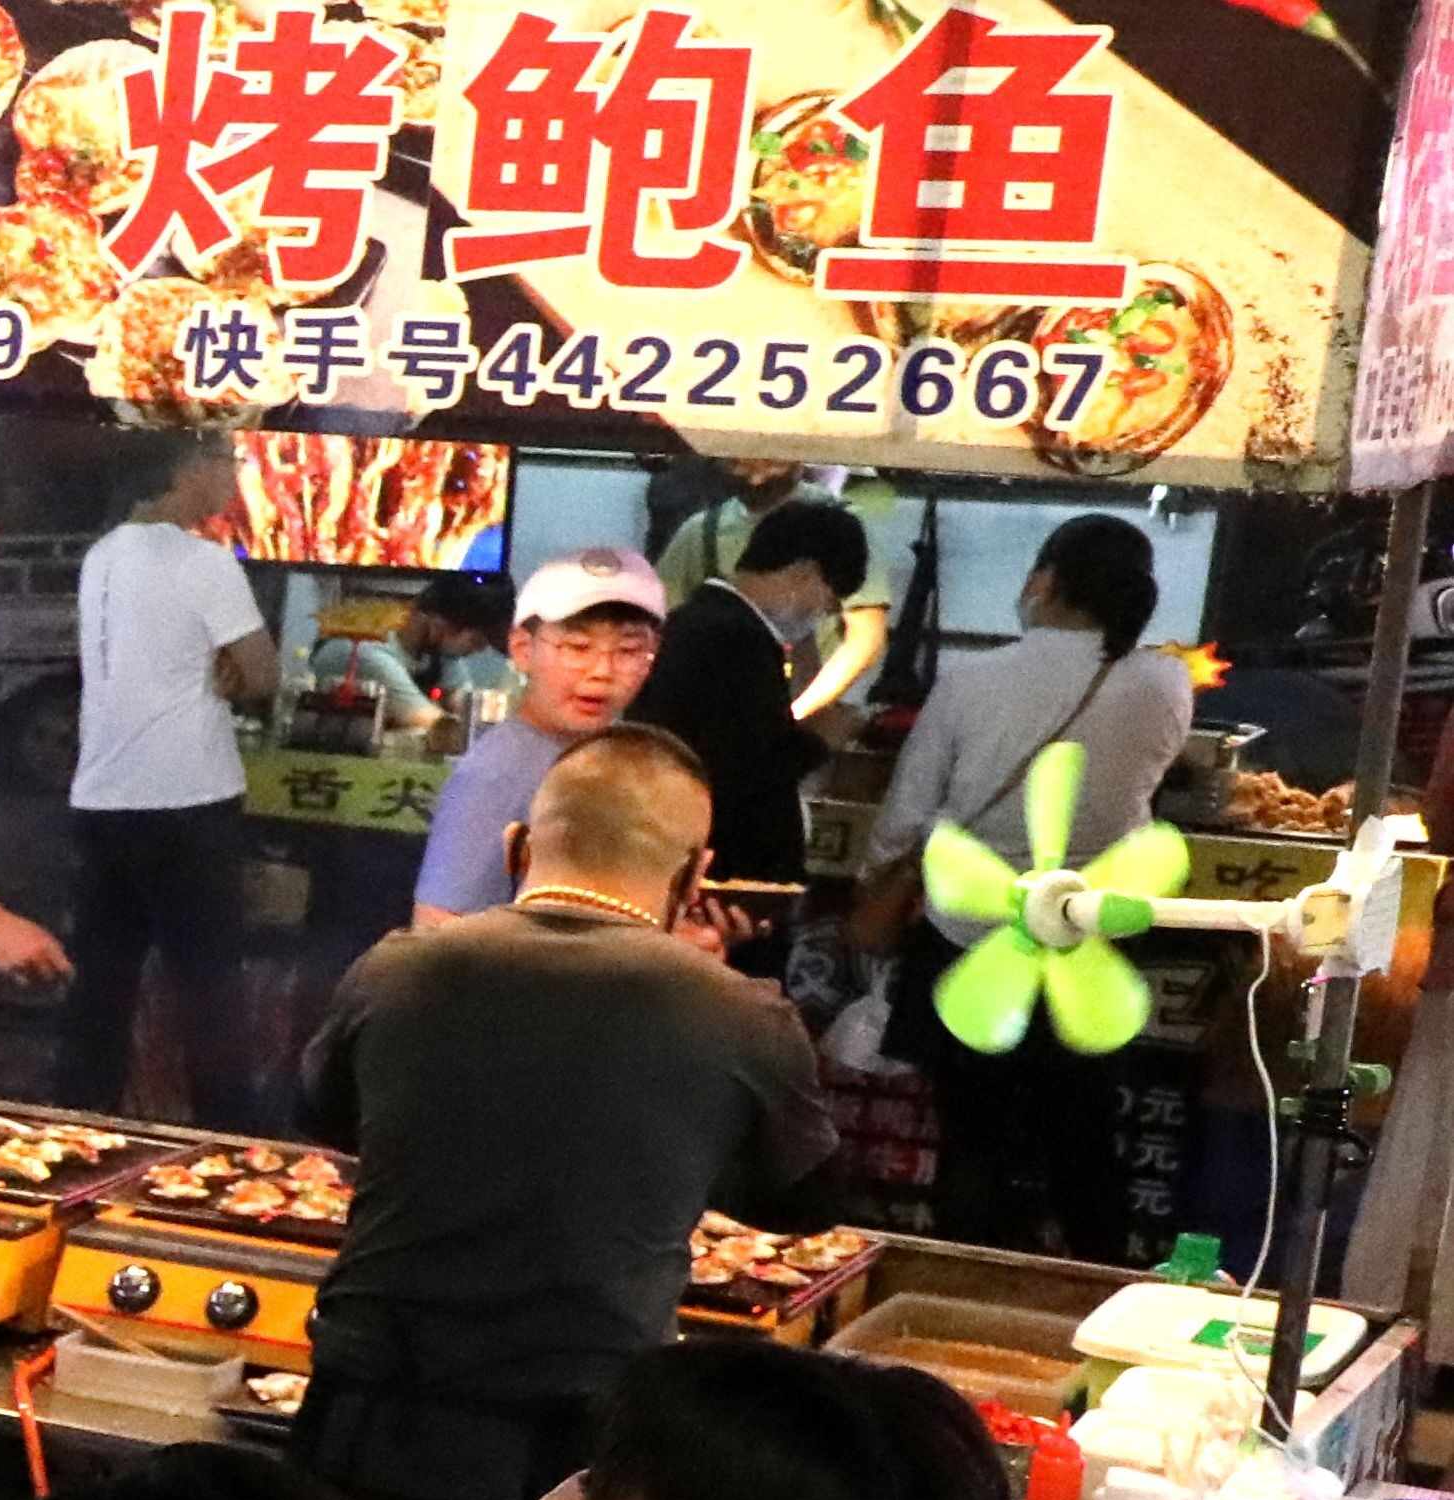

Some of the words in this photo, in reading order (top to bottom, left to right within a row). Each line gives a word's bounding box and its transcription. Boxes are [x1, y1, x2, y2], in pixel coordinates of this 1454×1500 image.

[105, 10, 1130, 298] 烤鲍鱼
[185, 311, 1104, 424] 快手号442252667
